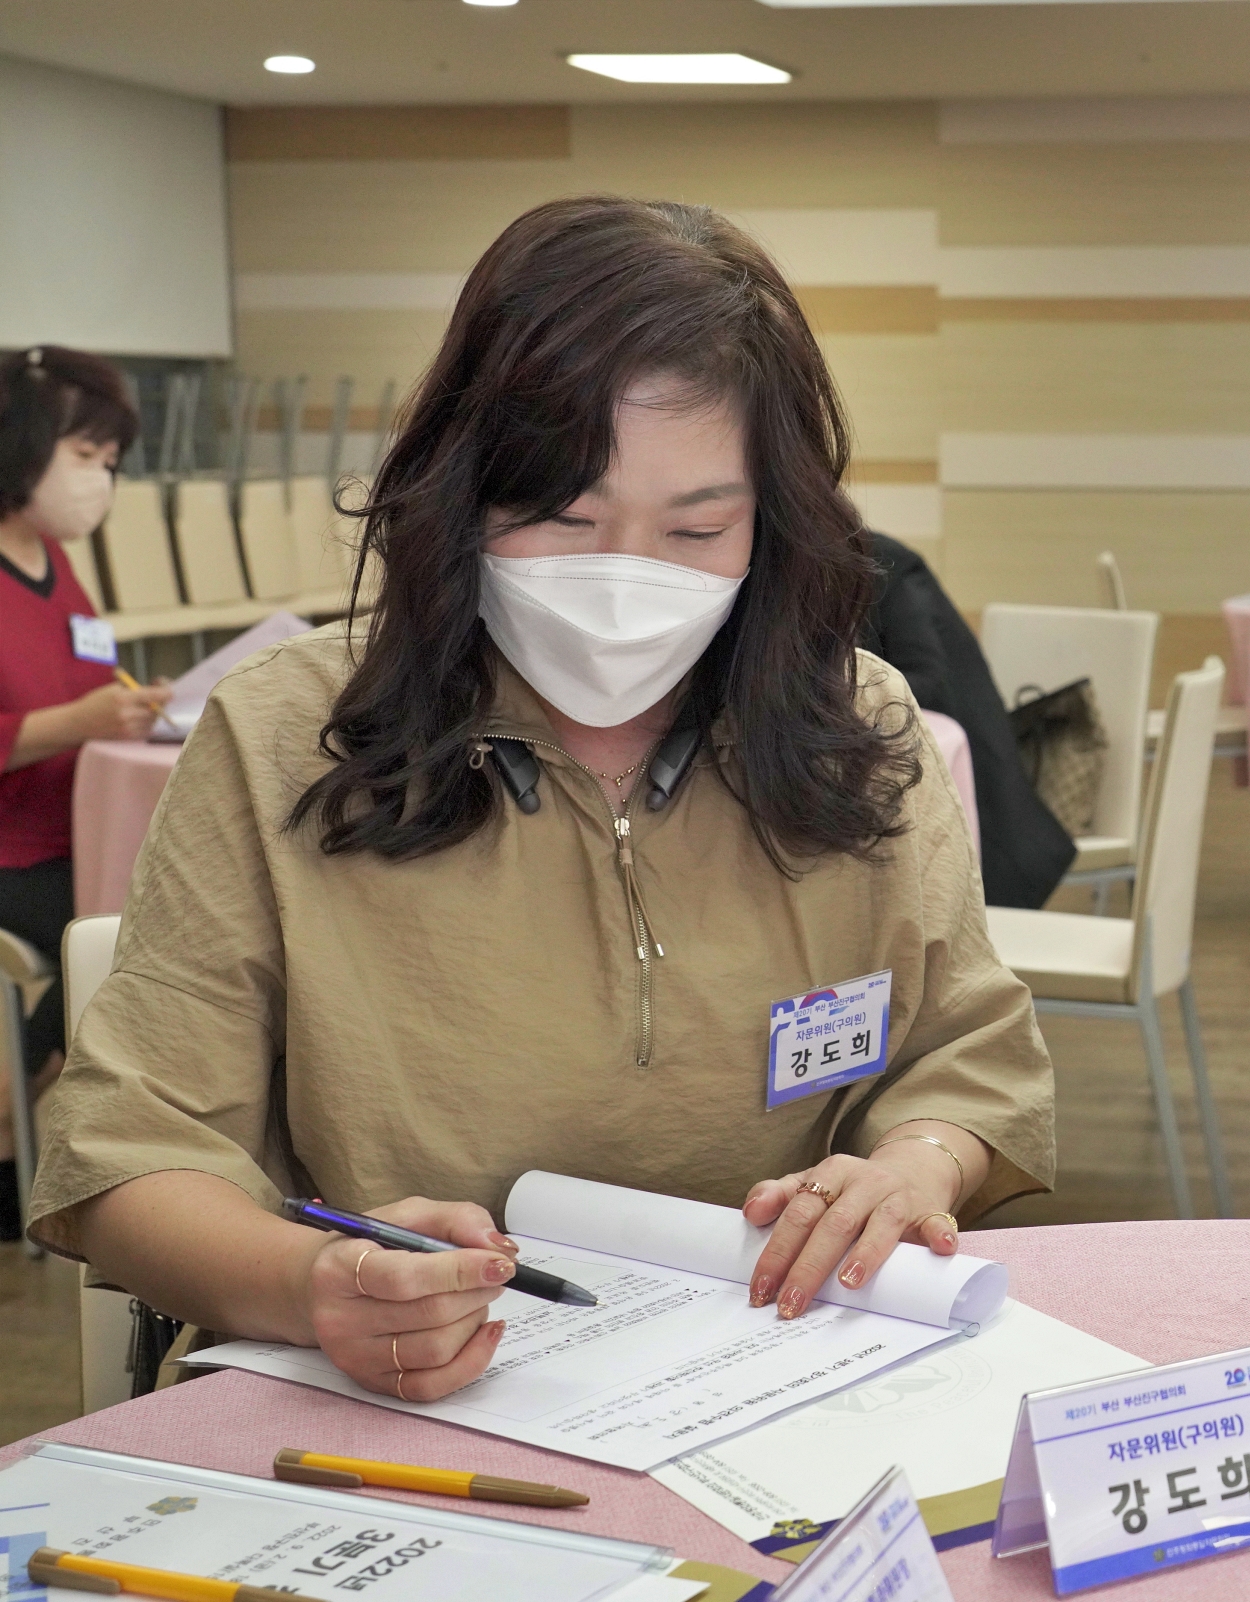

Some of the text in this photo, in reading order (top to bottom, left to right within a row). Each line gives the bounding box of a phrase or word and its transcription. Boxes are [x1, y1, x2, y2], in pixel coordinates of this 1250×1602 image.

[796, 1012, 867, 1041] 자문위원(구의원)
[814, 1003, 826, 1013] 부산
[1065, 1384, 1187, 1421] 제20기 부산 부산진구협의회
[1108, 1414, 1245, 1463] 자문위원(구의원)
[292, 1529, 396, 1577] 3분기
[334, 1537, 443, 1591] 2022년
